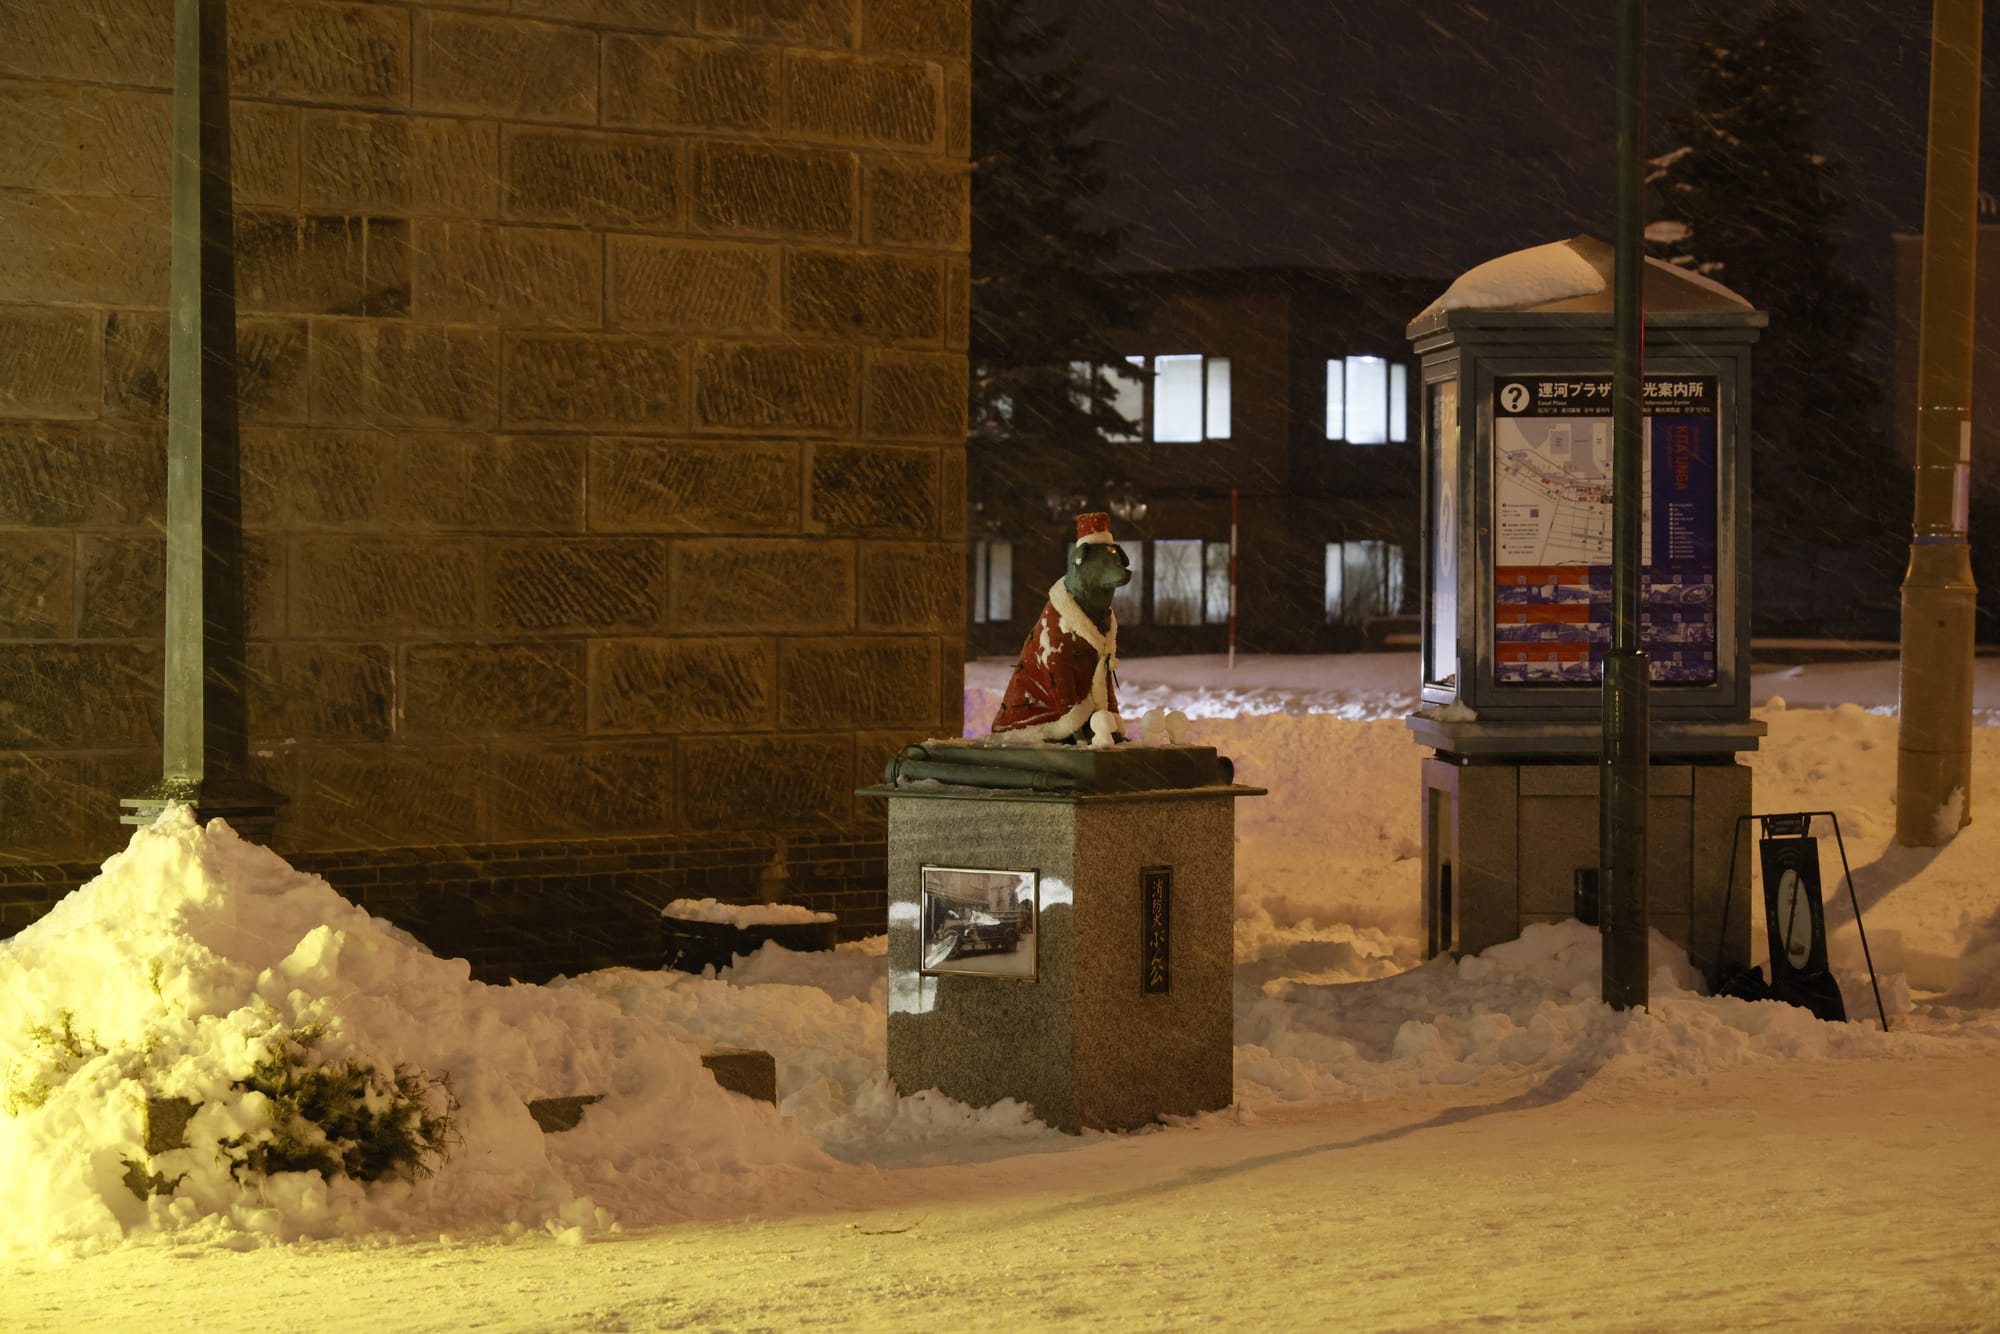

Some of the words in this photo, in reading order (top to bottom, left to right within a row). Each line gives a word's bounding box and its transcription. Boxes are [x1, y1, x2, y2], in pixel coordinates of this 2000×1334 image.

[1538, 382, 1612, 398] 運河プラザ
[1642, 382, 1704, 398] 光案内所
[1676, 425, 1689, 452] KITA
